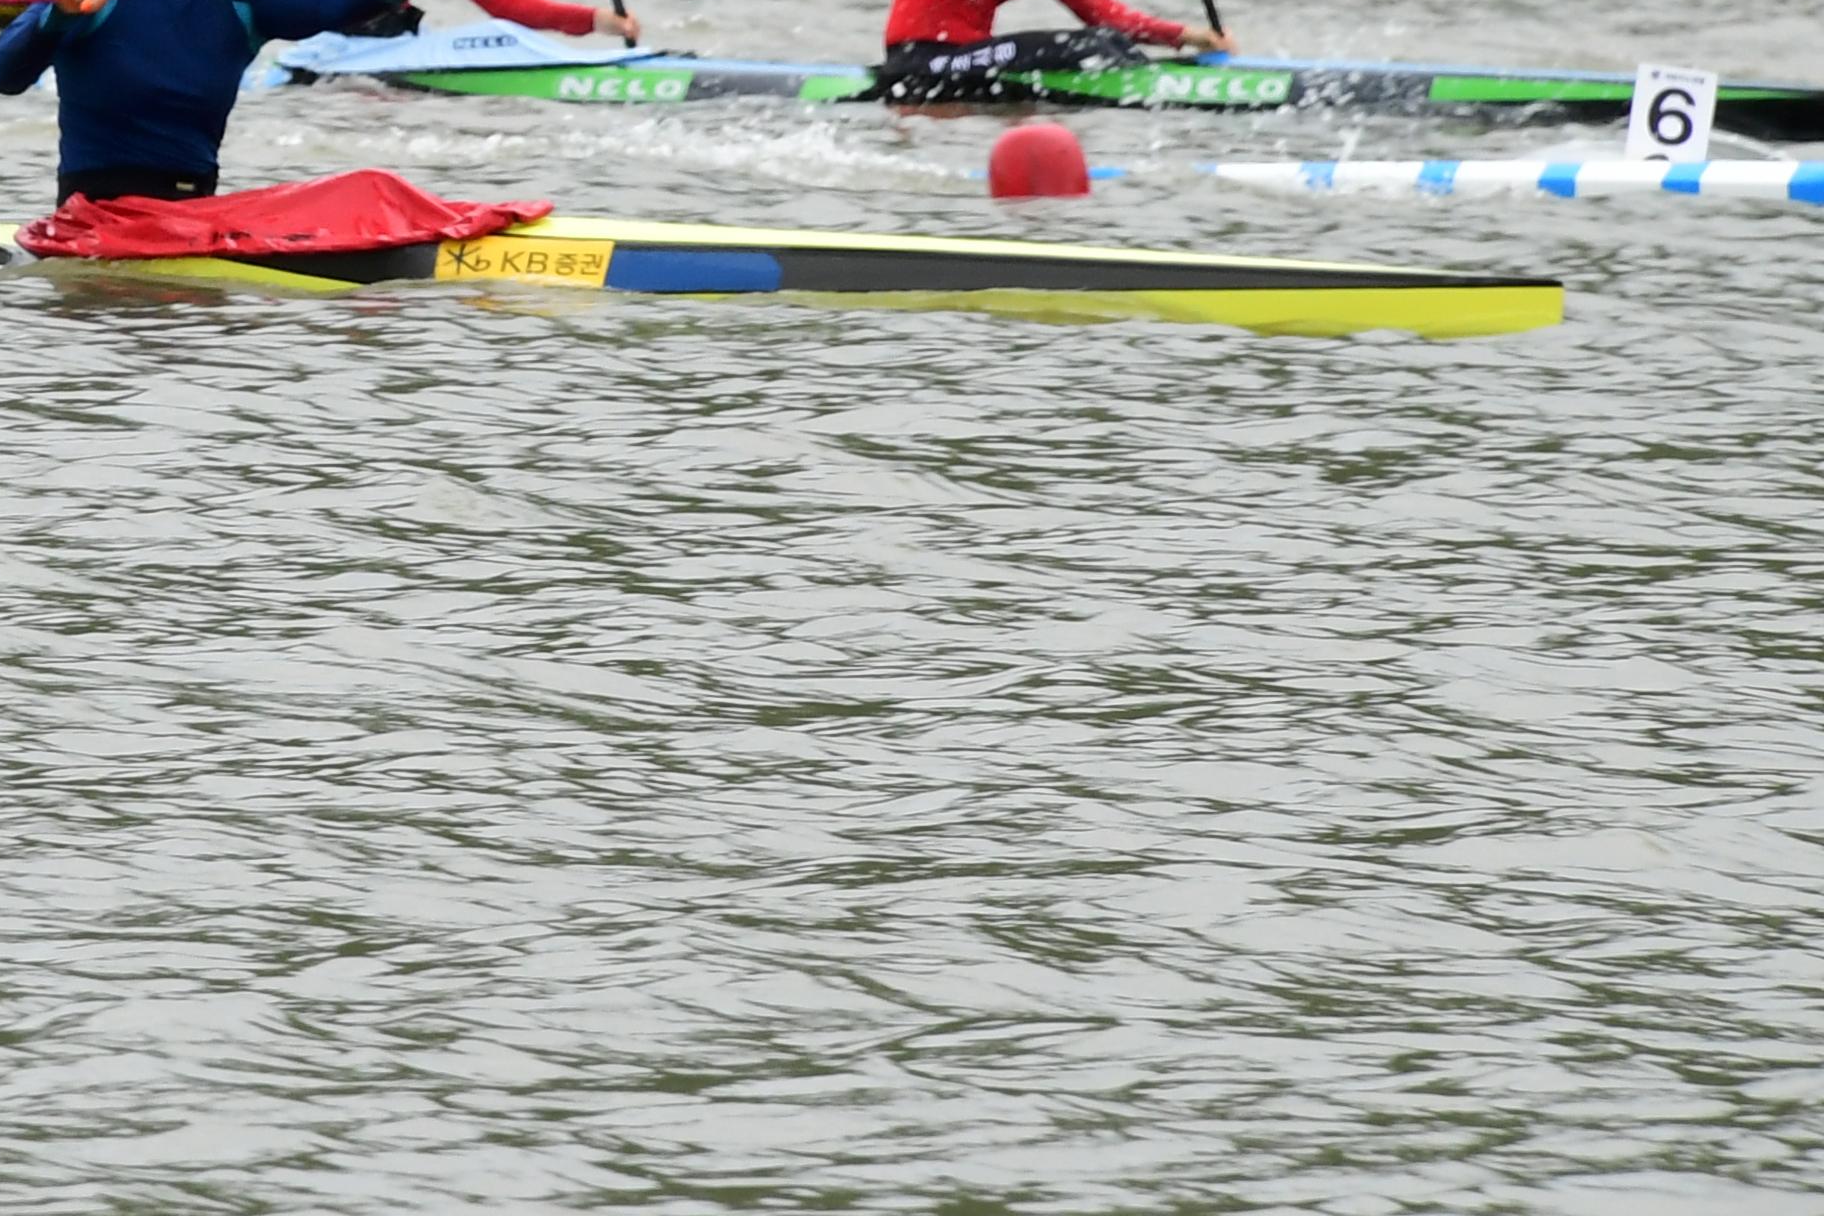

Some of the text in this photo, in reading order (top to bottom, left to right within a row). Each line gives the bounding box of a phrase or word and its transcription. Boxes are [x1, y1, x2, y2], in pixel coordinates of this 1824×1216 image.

[559, 76, 682, 98] NELO
[1154, 74, 1284, 99] NELO
[1648, 88, 1696, 146] 6
